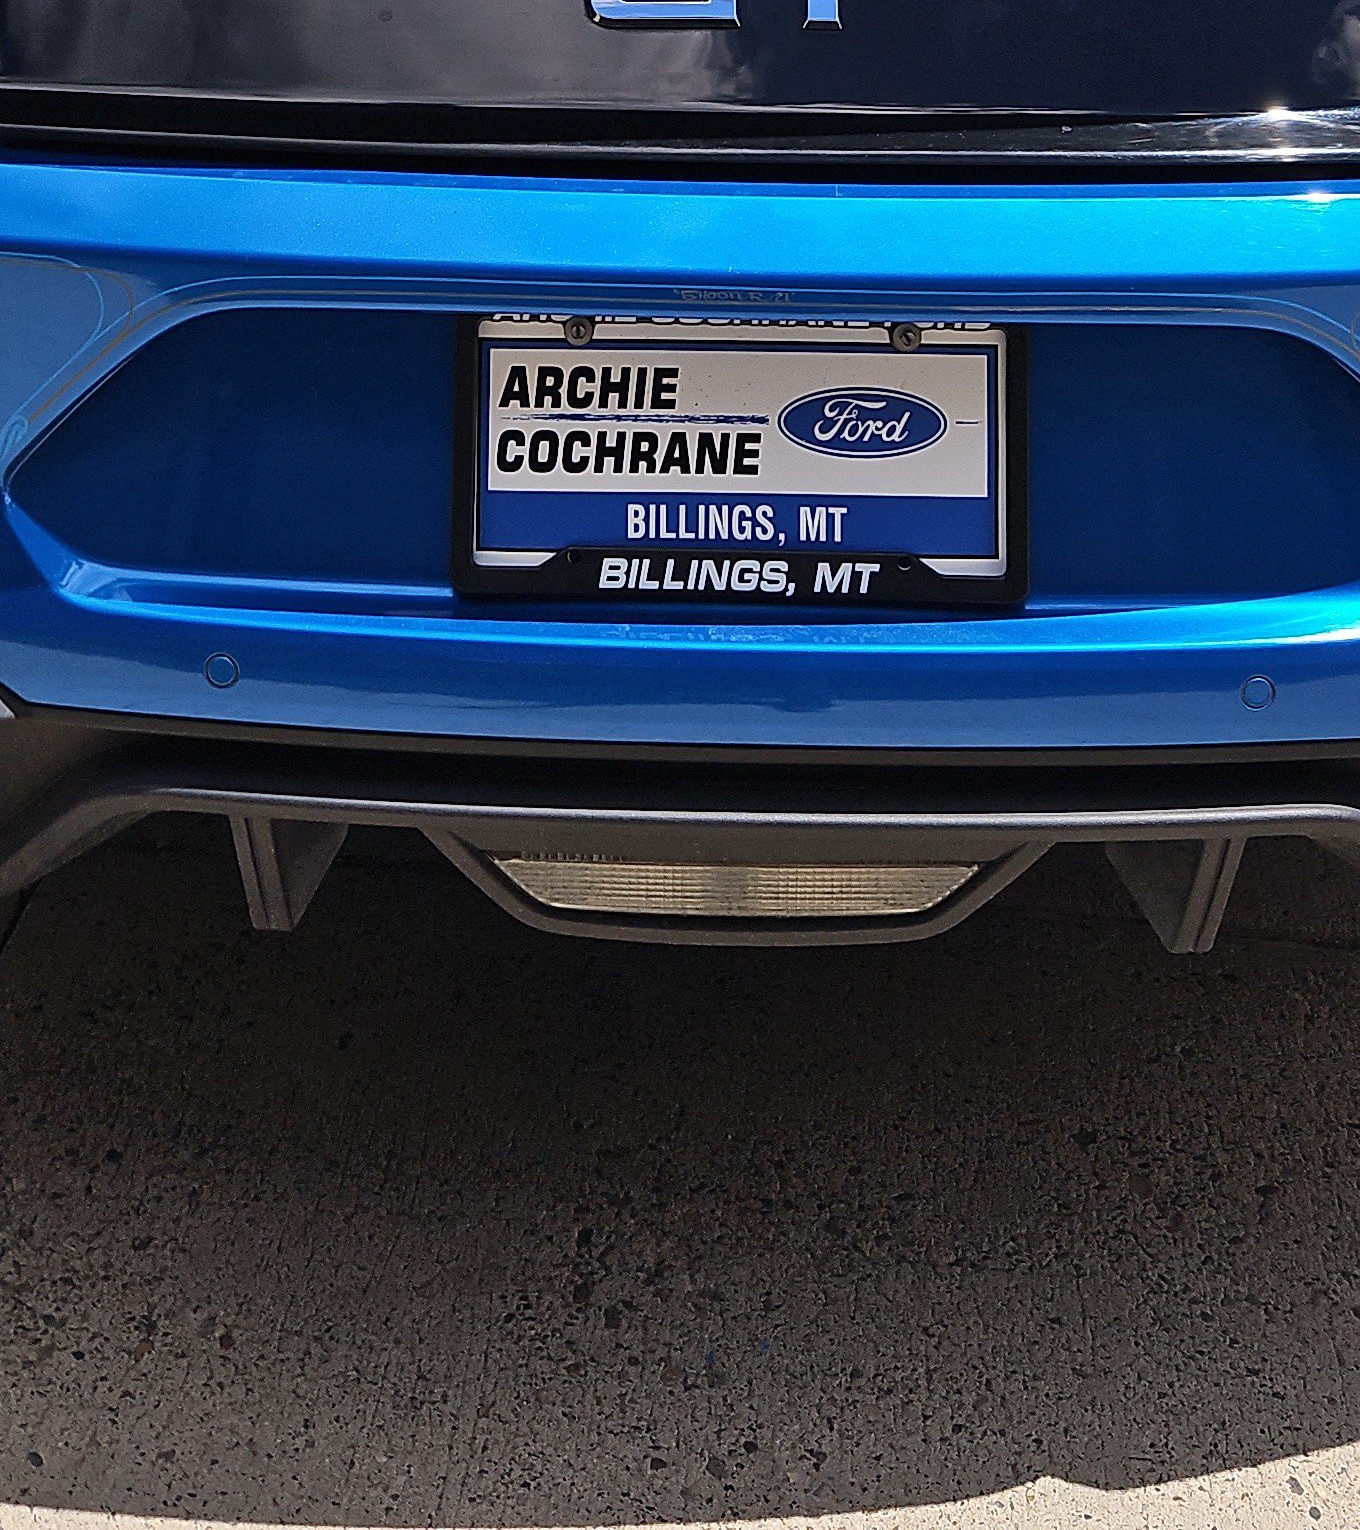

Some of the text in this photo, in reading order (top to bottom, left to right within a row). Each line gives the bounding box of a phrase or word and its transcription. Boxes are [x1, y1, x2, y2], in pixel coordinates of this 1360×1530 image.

[498, 365, 680, 410] ARCHIE
[813, 398, 911, 443] Ford
[496, 429, 762, 475] COCHRANE
[627, 503, 848, 546] BILLINGS, MT
[598, 557, 881, 596] BILLINGS, MT
